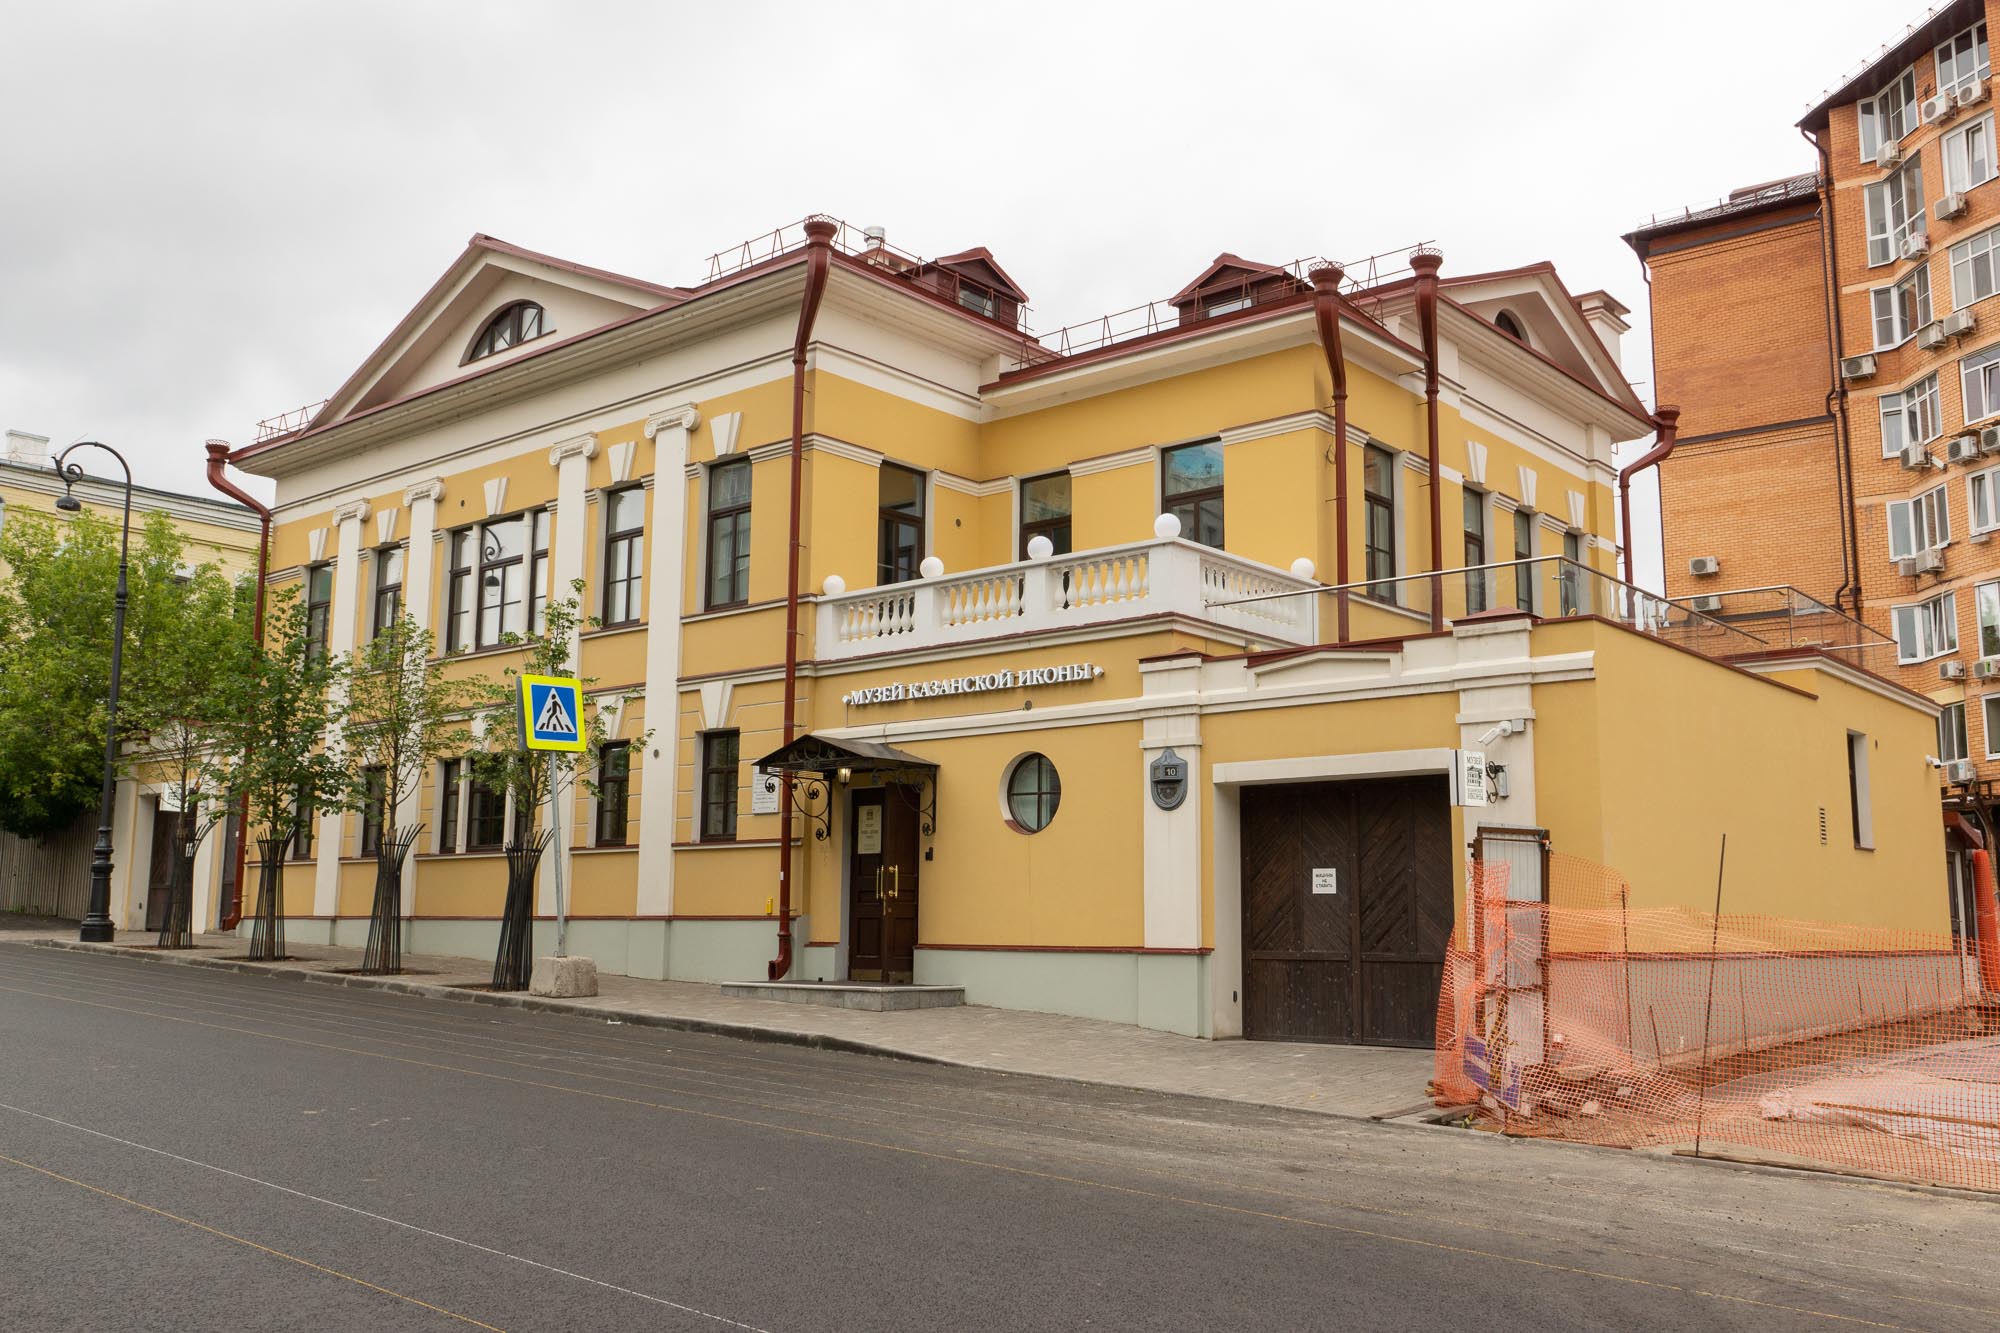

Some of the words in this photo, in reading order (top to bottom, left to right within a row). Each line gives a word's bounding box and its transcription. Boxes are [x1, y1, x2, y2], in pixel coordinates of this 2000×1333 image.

[850, 682, 906, 705] МУЗЕЙ
[908, 669, 1016, 698] КАЗАНСКОЙ
[1018, 662, 1094, 686] ИКОНЫ
[1466, 755, 1483, 766] МУЗЕЙ
[1165, 768, 1176, 776] 10
